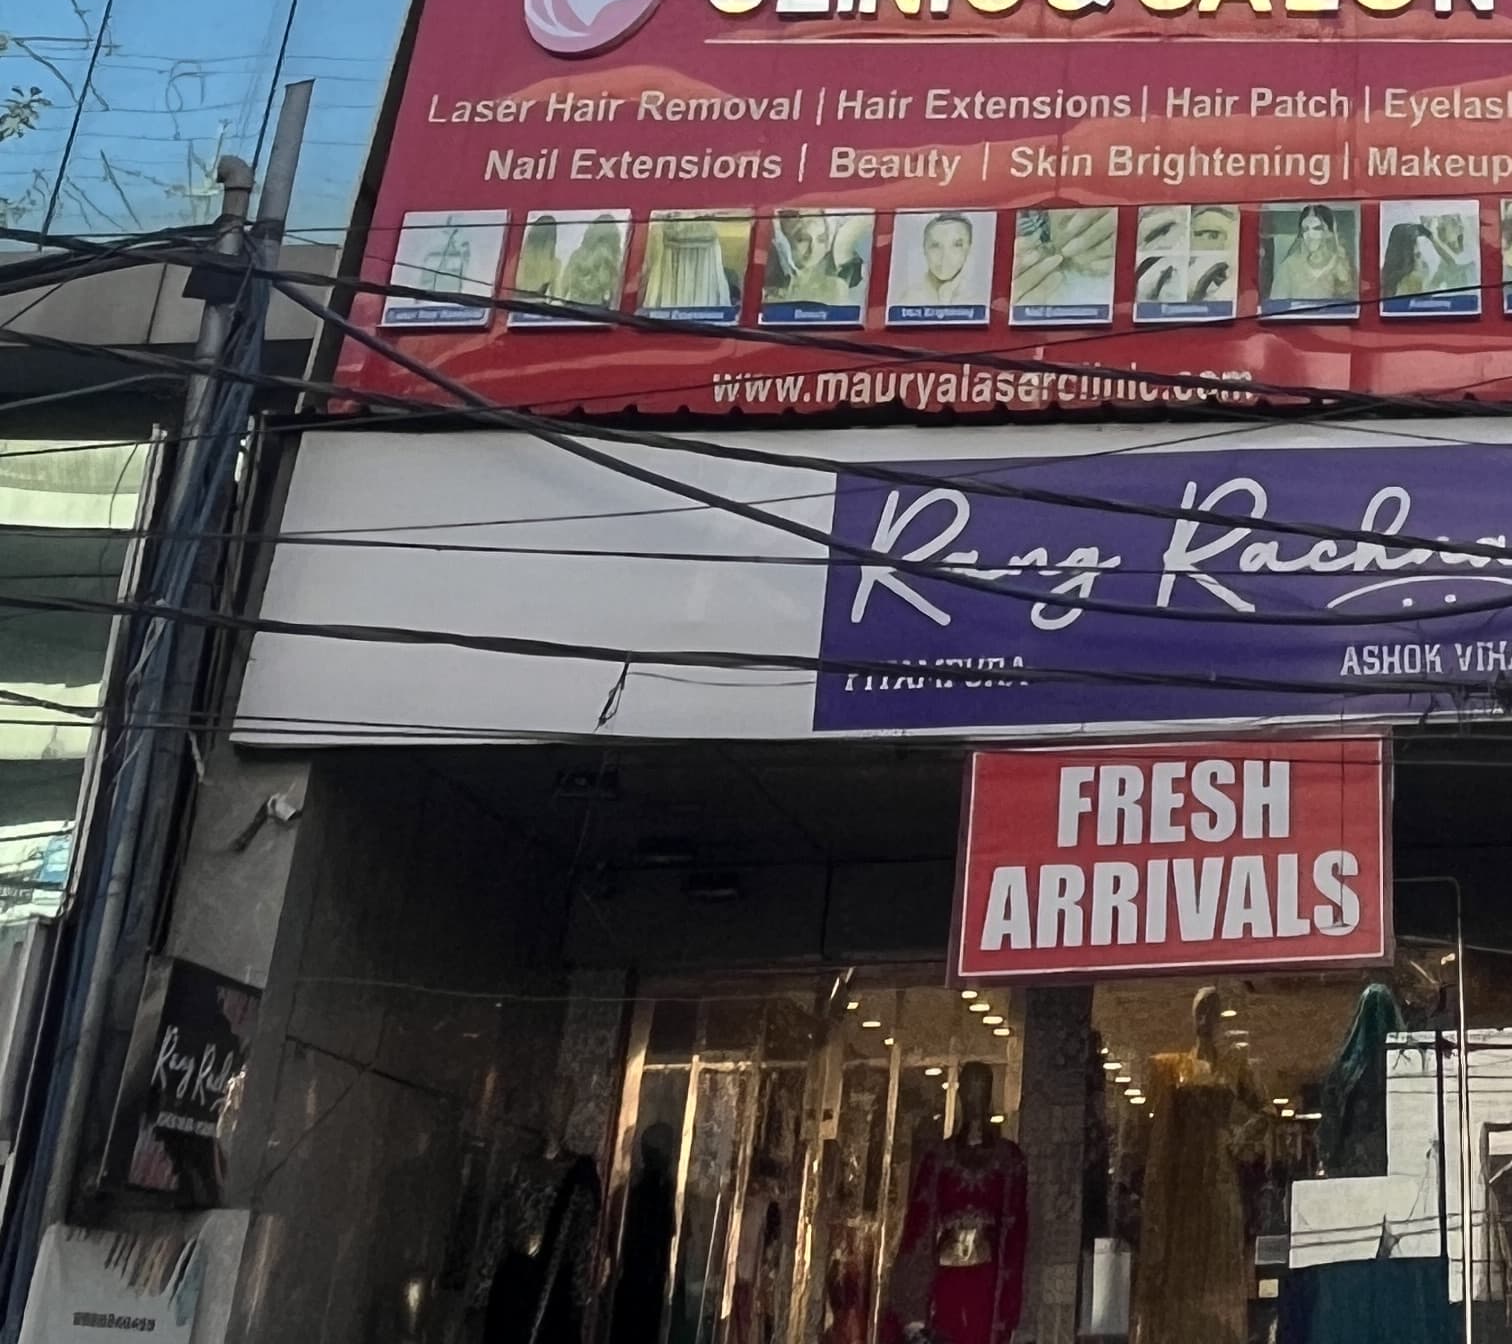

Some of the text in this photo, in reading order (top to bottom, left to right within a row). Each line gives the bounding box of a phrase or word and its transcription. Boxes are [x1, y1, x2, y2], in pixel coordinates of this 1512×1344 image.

[429, 93, 535, 123] Laser
[546, 90, 625, 122] Hair
[637, 89, 803, 122] Removal
[837, 88, 917, 121] Hair
[924, 87, 1131, 121] Extensions
[1166, 87, 1240, 119] Hair
[1250, 87, 1350, 120] Patch
[484, 148, 558, 180] Nail
[570, 148, 782, 181] Extensions
[829, 146, 960, 185] Beauty
[1010, 145, 1093, 179] Skin
[1108, 145, 1332, 186] Brightening
[1341, 644, 1442, 676] ASHOK
[1058, 759, 1291, 848] FRESH
[981, 850, 1360, 952] ARRIVALS
